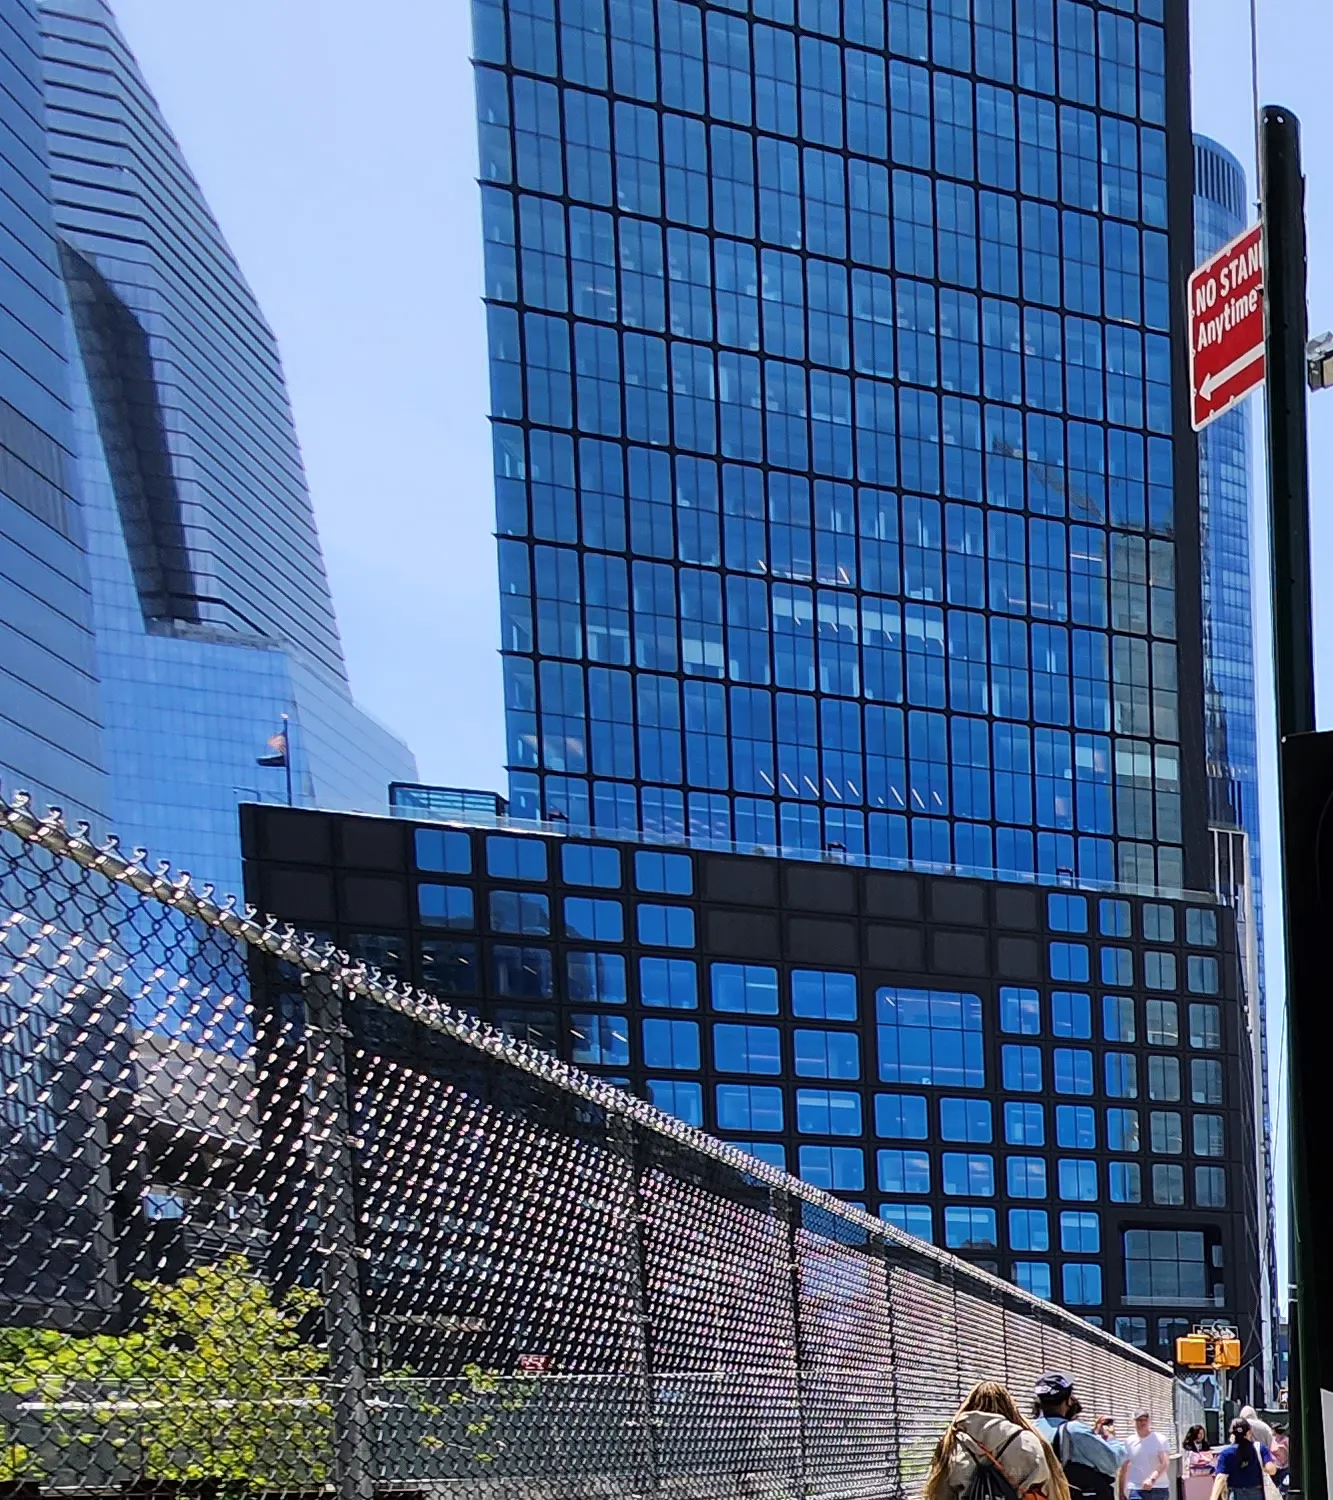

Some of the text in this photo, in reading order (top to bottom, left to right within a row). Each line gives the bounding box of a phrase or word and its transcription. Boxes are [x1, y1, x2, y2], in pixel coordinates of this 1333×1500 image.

[1196, 239, 1263, 316] NO STAN
[1198, 288, 1258, 351] Anytime
